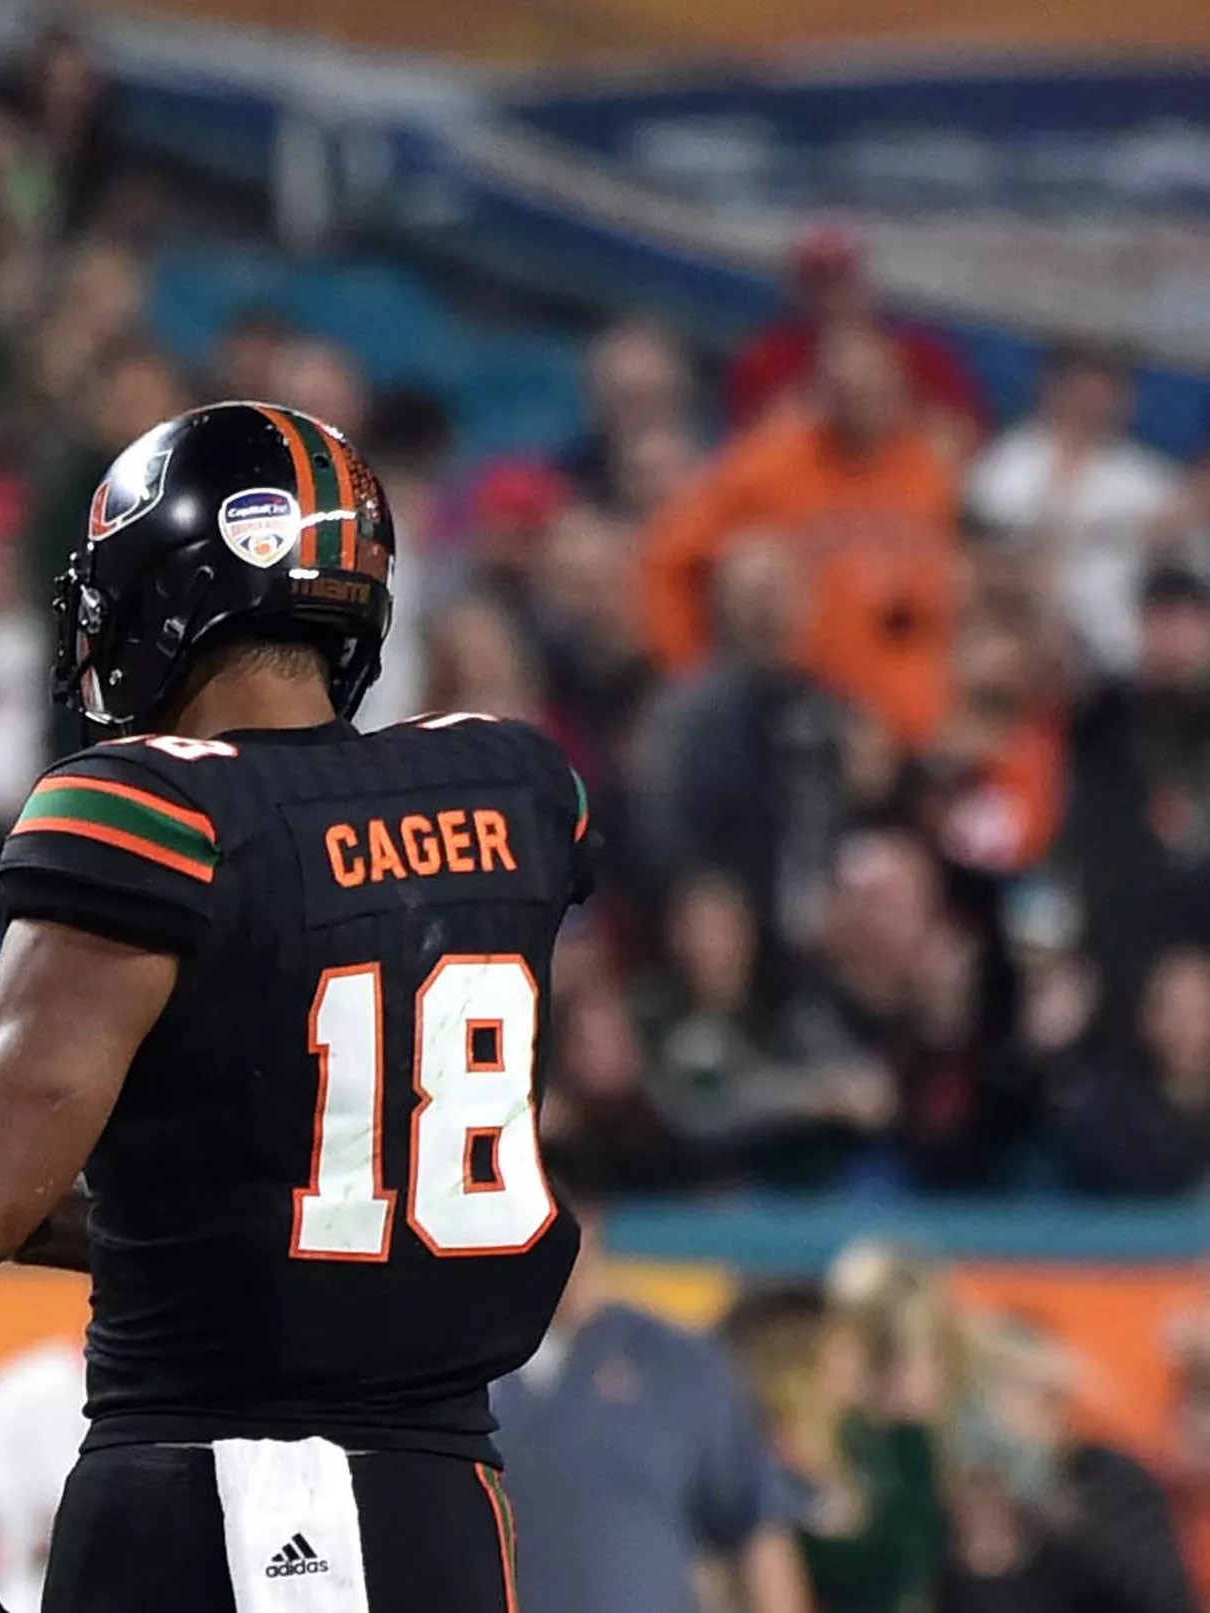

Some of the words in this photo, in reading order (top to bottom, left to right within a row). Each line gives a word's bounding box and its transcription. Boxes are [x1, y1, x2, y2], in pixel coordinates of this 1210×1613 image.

[325, 808, 517, 888] CAGER
[289, 953, 559, 1263] 18
[265, 1559, 329, 1579] adidas
